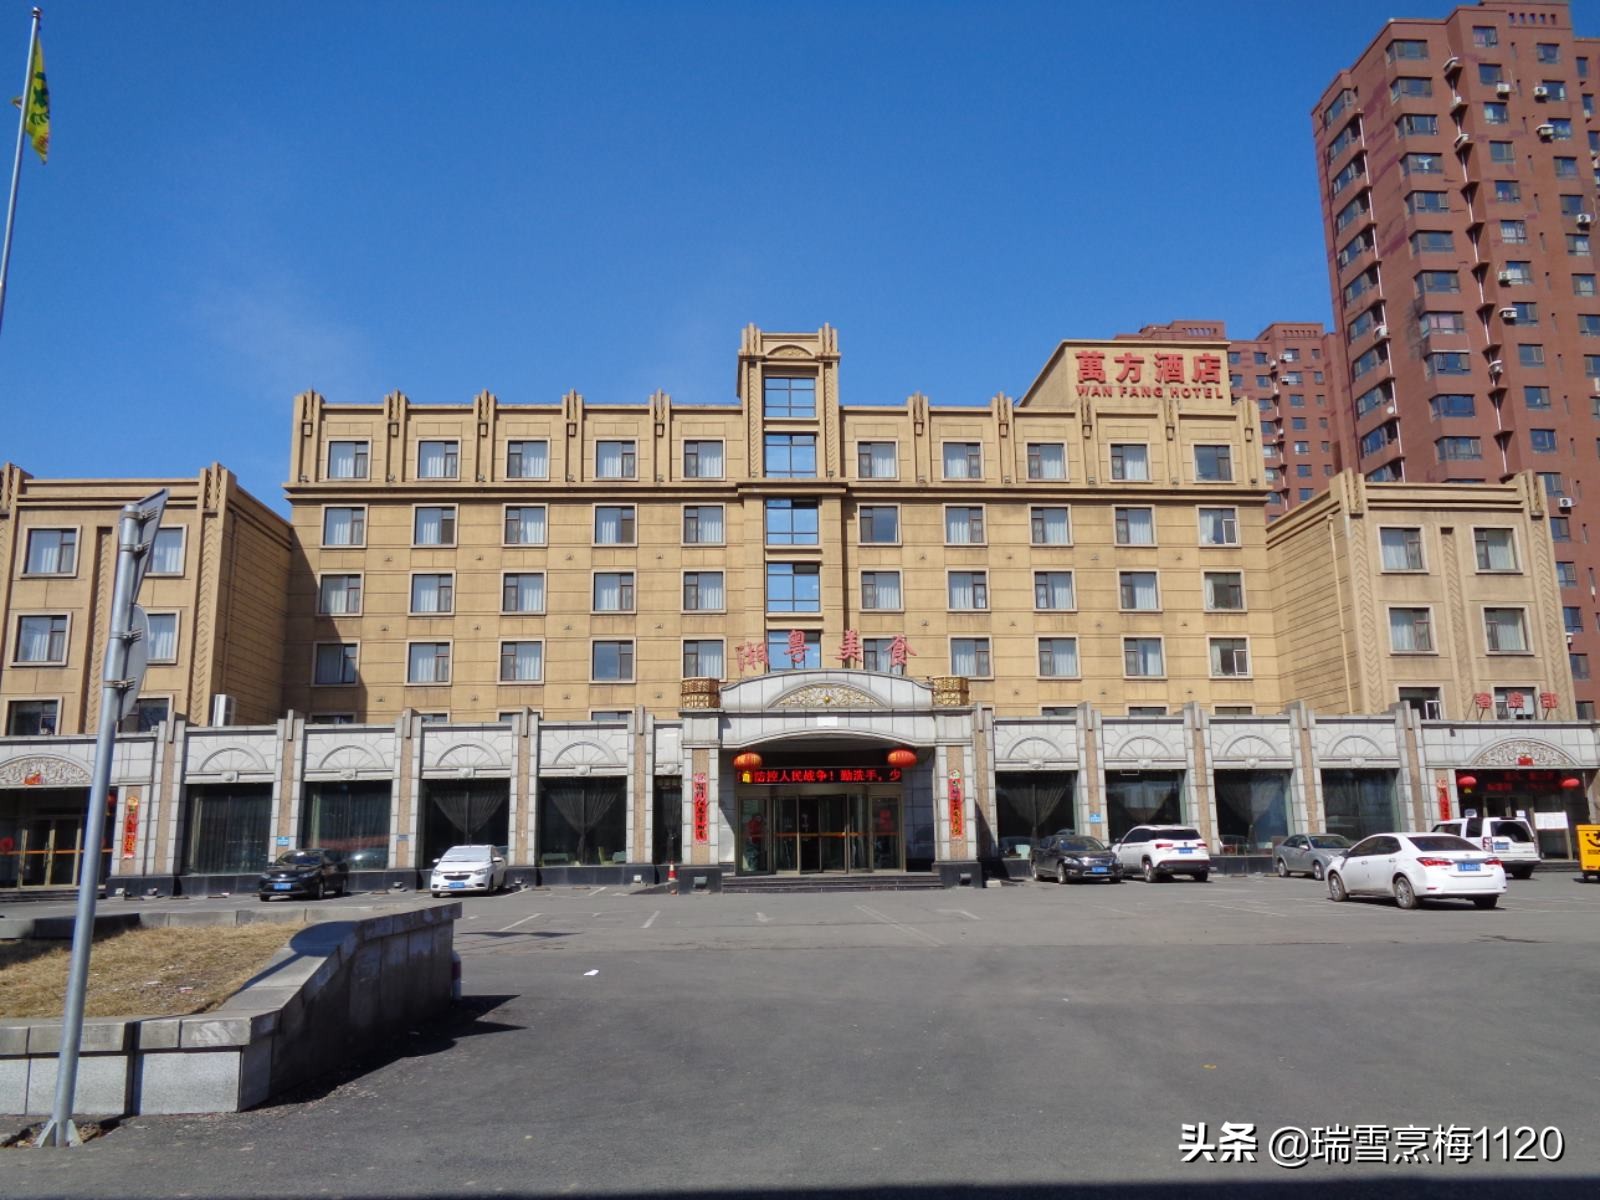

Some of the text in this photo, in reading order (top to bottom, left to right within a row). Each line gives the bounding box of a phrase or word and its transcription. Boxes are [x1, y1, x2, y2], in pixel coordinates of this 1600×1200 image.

[1075, 350, 1222, 384] 萬方酒店
[1076, 385, 1223, 399] WAN FANG HOTEL
